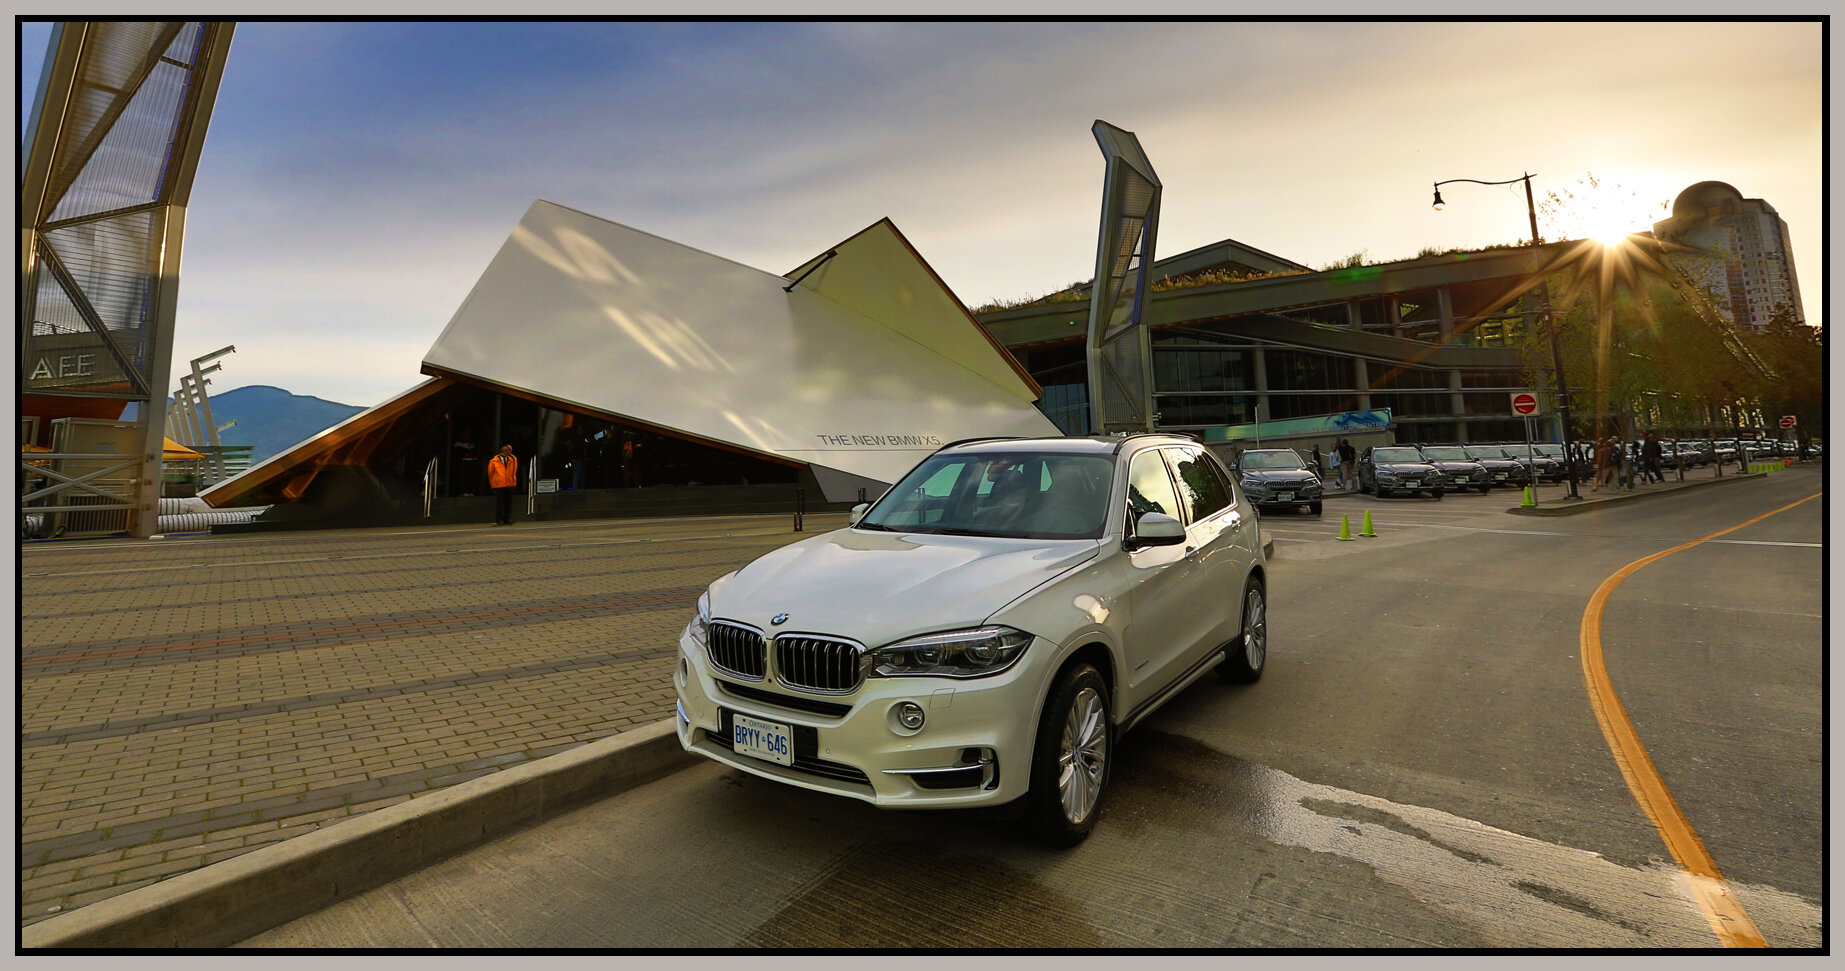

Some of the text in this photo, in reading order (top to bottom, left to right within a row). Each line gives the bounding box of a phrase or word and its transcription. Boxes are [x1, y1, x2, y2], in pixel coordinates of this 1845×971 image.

[816, 434, 851, 446] THE
[851, 435, 885, 446] NEW
[886, 435, 922, 446] BMW
